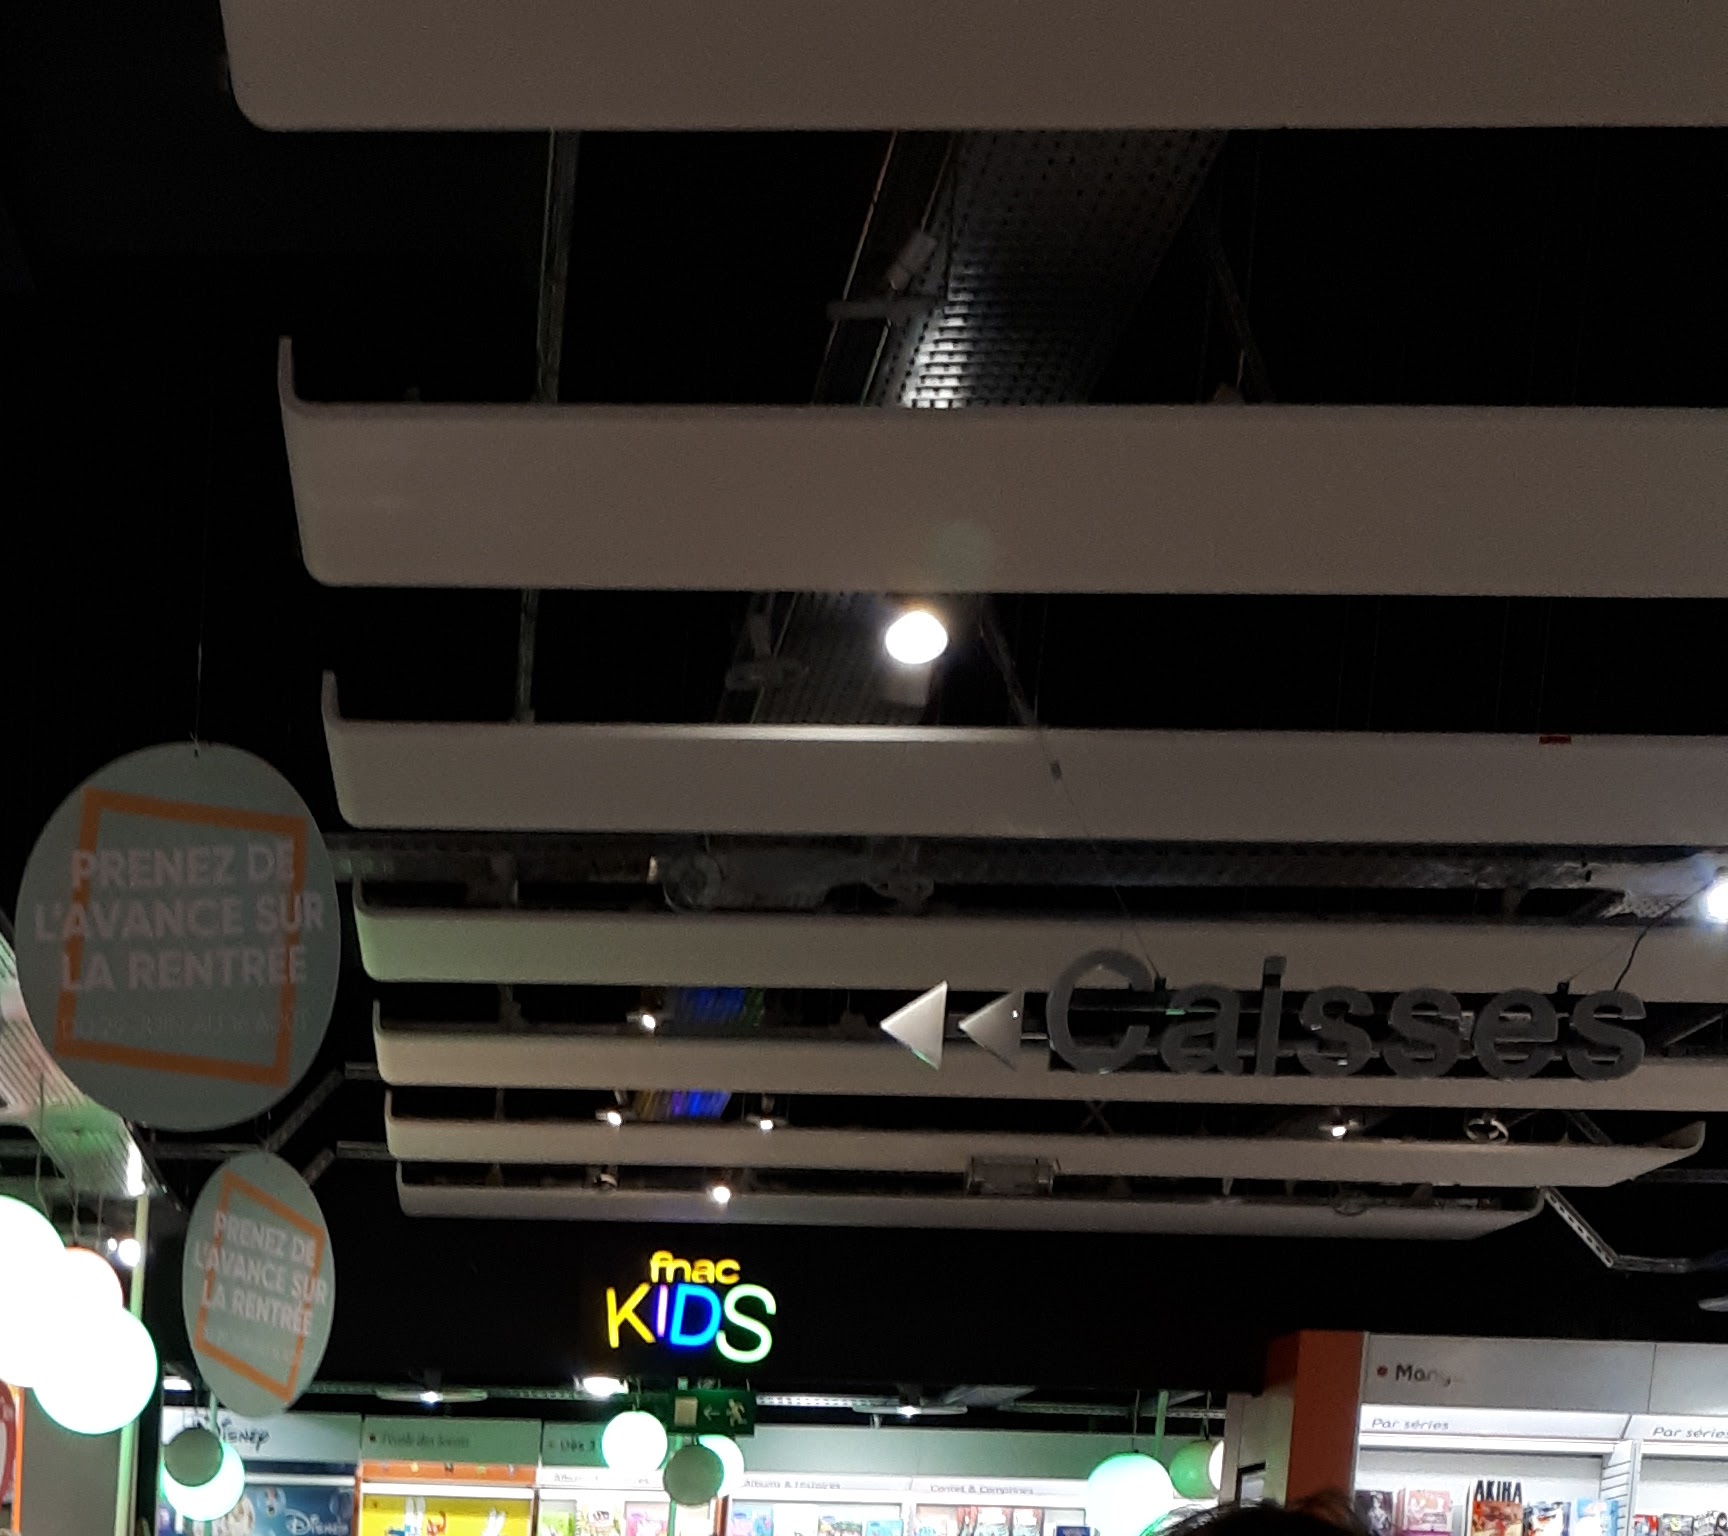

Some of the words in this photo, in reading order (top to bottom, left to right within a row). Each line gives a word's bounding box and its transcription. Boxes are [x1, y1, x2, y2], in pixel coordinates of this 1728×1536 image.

[72, 847, 235, 888] PRENEZ
[248, 841, 294, 882] DE
[35, 899, 245, 940] L'AVANCE
[257, 891, 324, 933] SUR
[62, 949, 115, 992] LA
[1046, 949, 1646, 1081] Caisses
[214, 1210, 286, 1256] PRENEZ
[292, 1238, 315, 1267] DE
[292, 1274, 327, 1305] SUR
[650, 1250, 740, 1285] fnac
[606, 1282, 776, 1363] KIDS
[1372, 1417, 1399, 1429] Par
[1404, 1418, 1449, 1431] séries
[1653, 1426, 1682, 1438] Par
